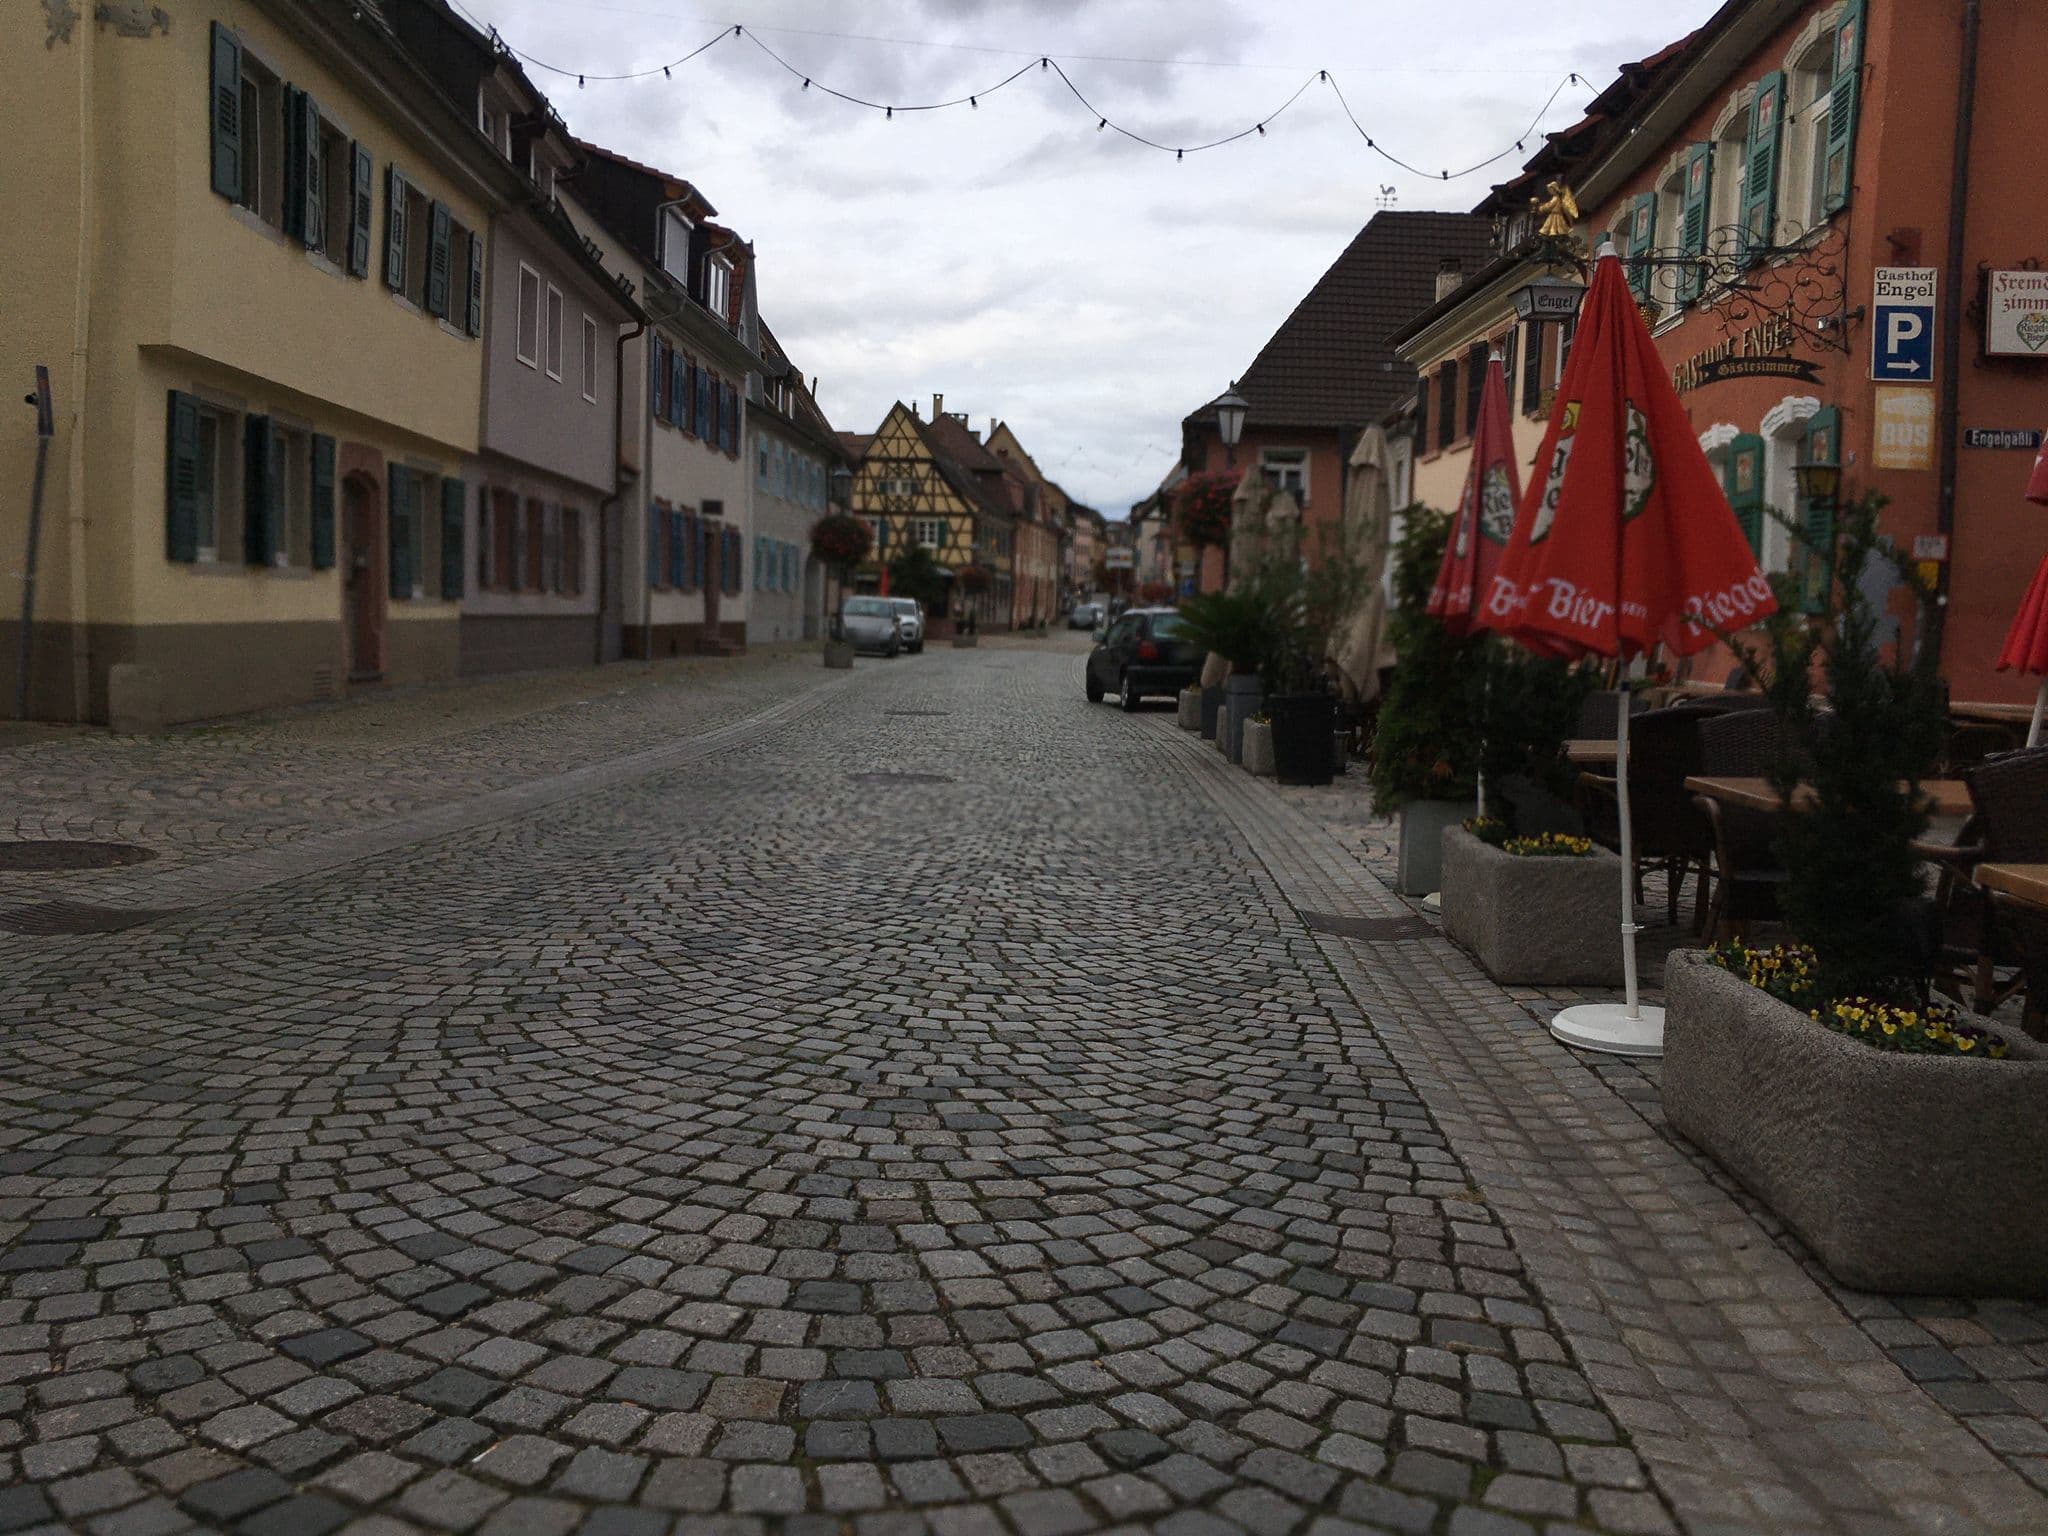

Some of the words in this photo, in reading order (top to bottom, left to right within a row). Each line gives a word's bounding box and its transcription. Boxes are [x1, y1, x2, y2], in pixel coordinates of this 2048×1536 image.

[1876, 268, 1936, 281] Gasthof
[1876, 282, 1934, 300] Engel
[1538, 295, 1573, 308] Engel
[1887, 312, 1923, 354] P
[1717, 361, 1801, 376] Gästezimmer
[1546, 577, 1611, 629] Bier
